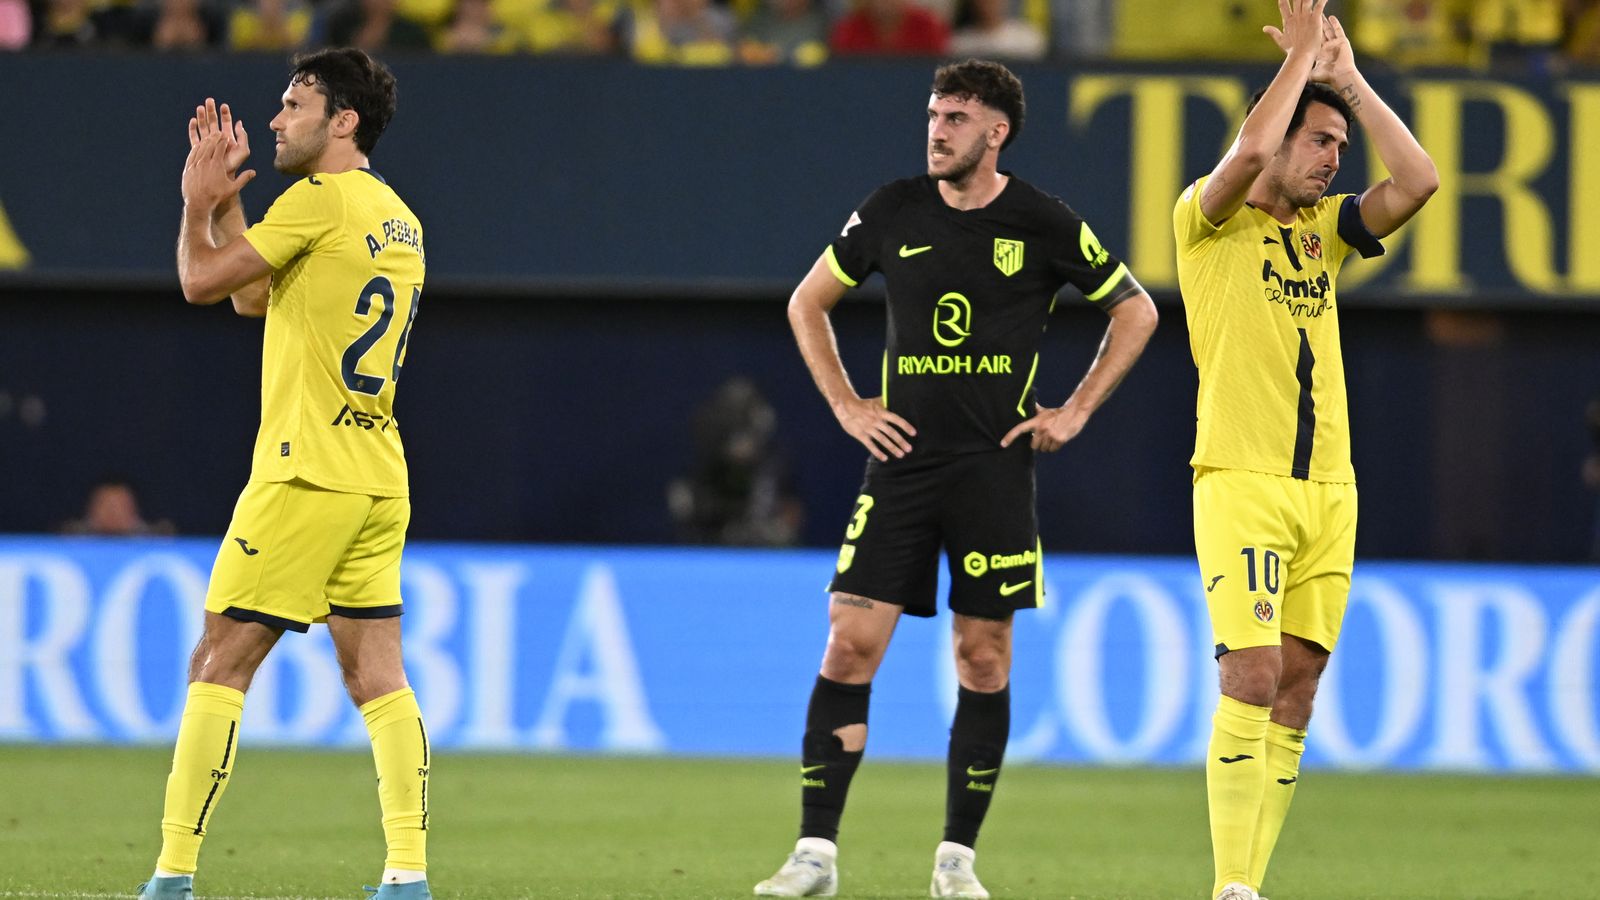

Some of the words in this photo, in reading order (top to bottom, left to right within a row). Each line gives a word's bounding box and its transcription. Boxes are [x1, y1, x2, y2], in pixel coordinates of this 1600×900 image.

[365, 218, 425, 264] A.PEDRA
[898, 355, 972, 374] RIYADH
[976, 355, 1012, 374] AIR
[846, 494, 874, 540] 3
[1240, 547, 1279, 595] 10
